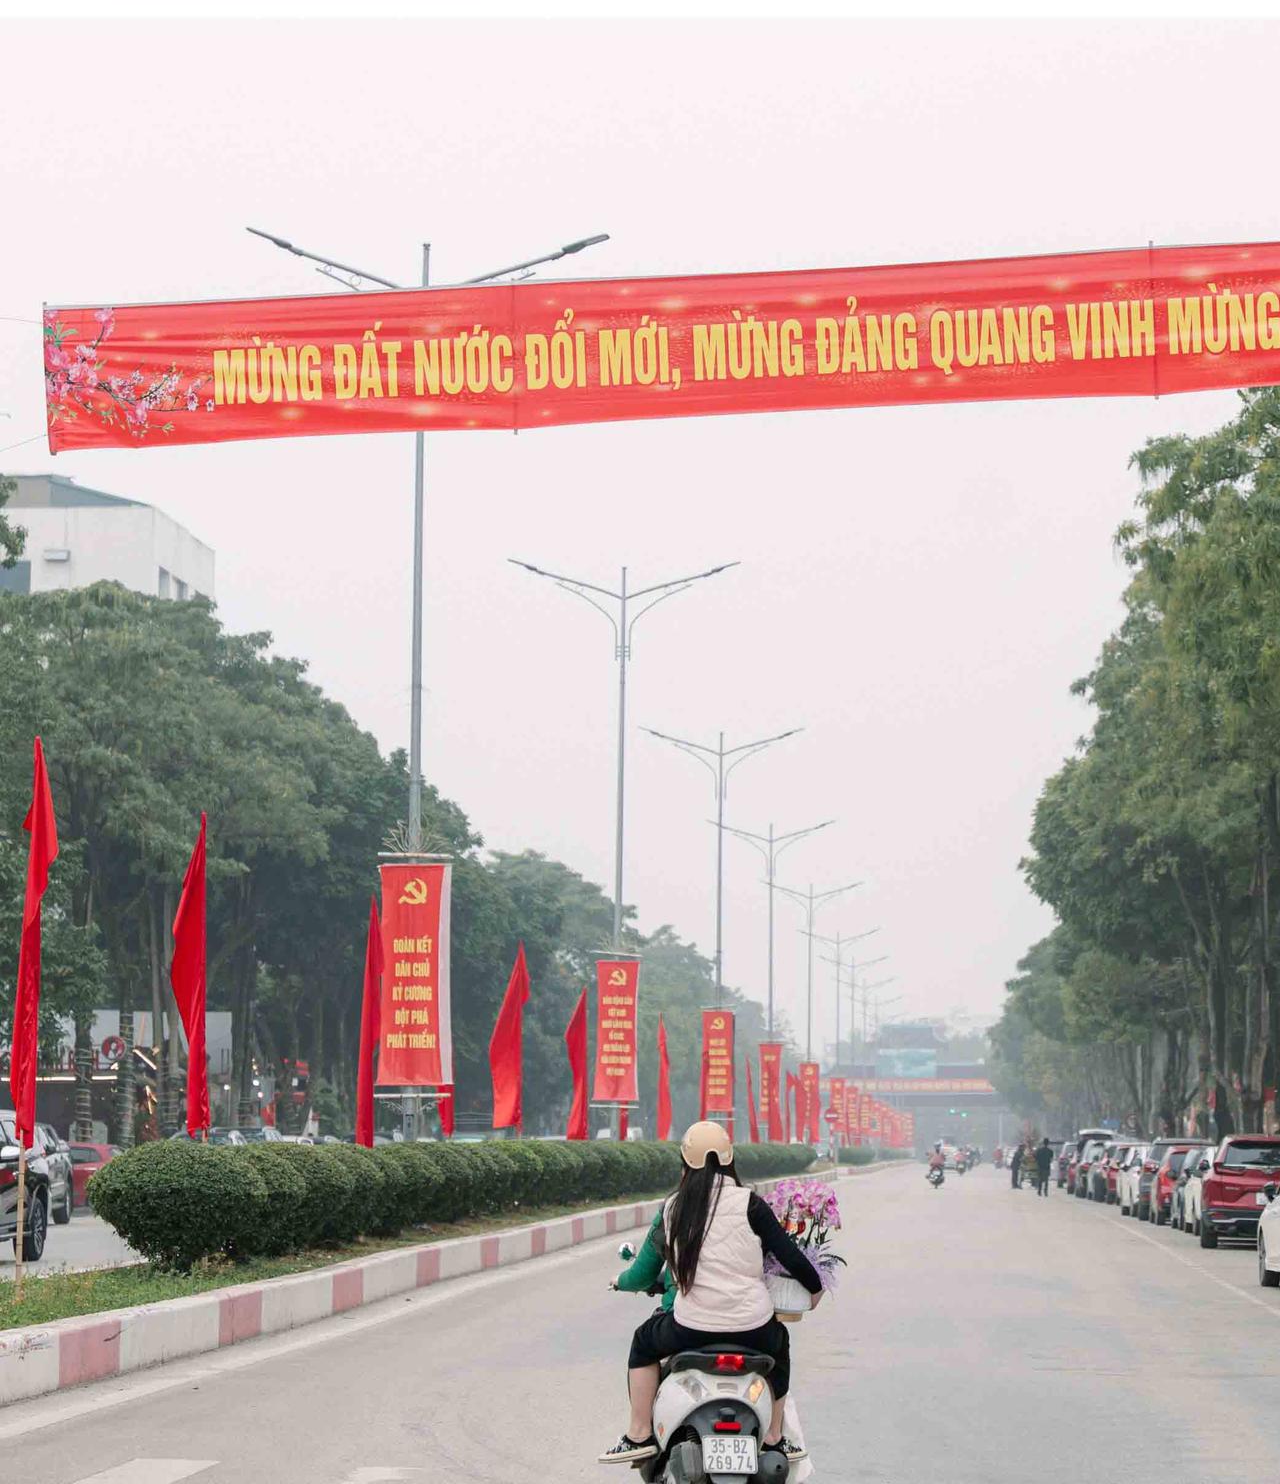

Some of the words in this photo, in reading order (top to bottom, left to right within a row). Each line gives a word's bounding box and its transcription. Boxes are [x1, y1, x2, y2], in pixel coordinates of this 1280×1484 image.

[213, 337, 323, 405] MỪNG
[332, 320, 402, 400] ĐẤT
[414, 323, 514, 396] NƯỚC
[524, 307, 586, 390] ĐỔI
[599, 314, 682, 391] MỚI,
[692, 309, 804, 381] MỪNG
[814, 296, 918, 375] ĐẢNG
[930, 304, 1055, 375] QUANG
[1066, 297, 1156, 360] VINH
[416, 935, 432, 954] KẾT
[395, 960, 411, 977] DÂN
[412, 958, 430, 977] CHỦ
[404, 985, 432, 1001] CƯƠNG
[395, 1009, 409, 1028] ĐỘT
[411, 1009, 429, 1025] PHÁ
[387, 1032, 409, 1048] PHÁT
[711, 1439, 747, 1453] 35-B2
[708, 1456, 752, 1470] 269.74
